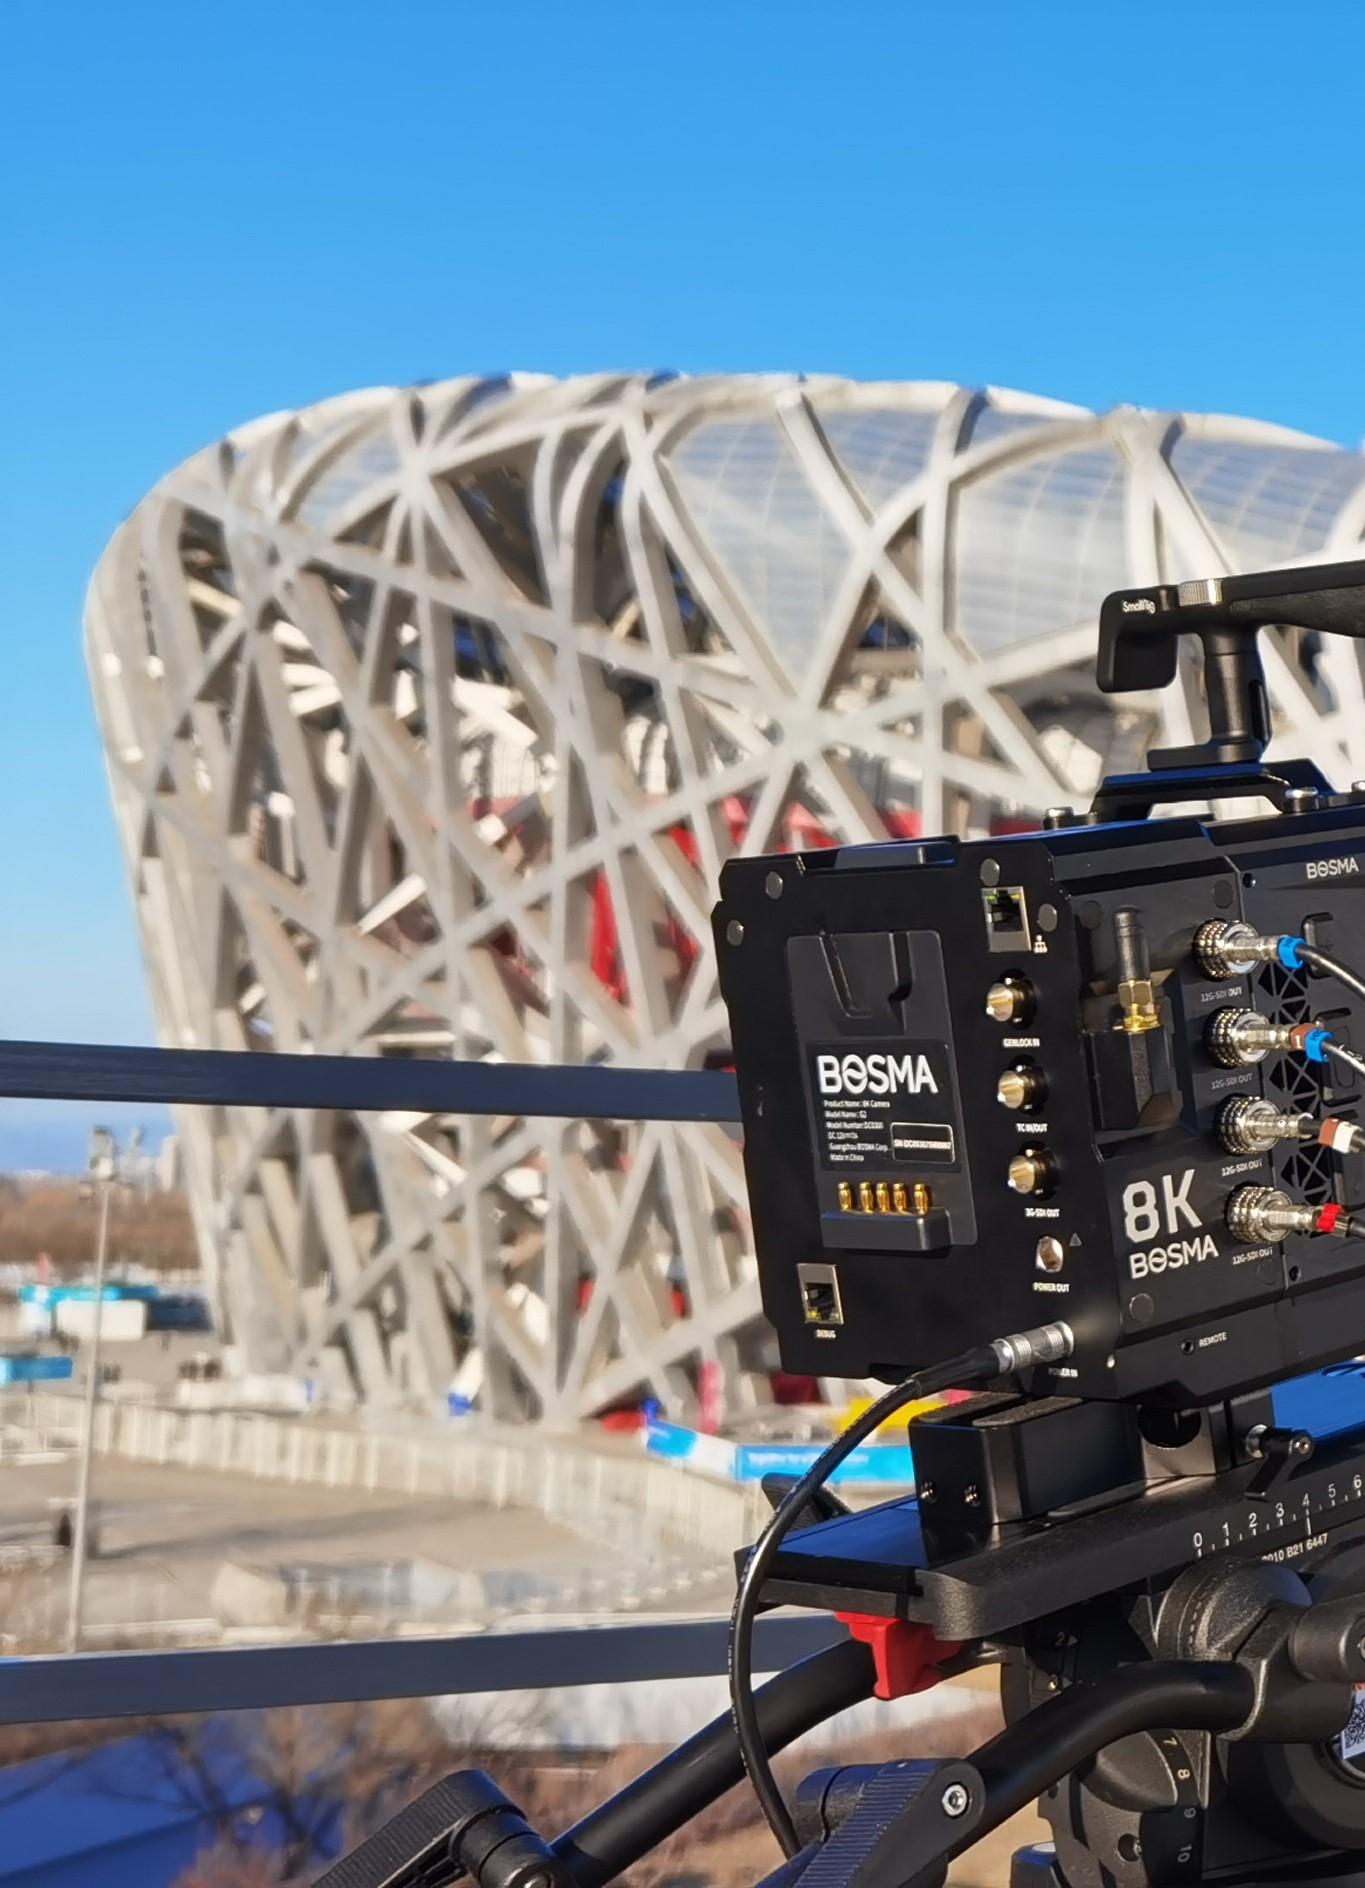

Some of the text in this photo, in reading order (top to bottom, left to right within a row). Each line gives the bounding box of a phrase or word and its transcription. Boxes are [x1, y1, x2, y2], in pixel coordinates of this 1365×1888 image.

[1306, 857, 1359, 879] BOSMA
[1228, 986, 1242, 997] OUT
[817, 1054, 939, 1093] BOSMA
[1238, 1072, 1253, 1084] OUT
[1015, 1122, 1025, 1133] TC
[1248, 1158, 1263, 1170] OUT
[1122, 1169, 1203, 1243] 8K
[1046, 1208, 1060, 1218] OUT
[1129, 1235, 1219, 1279] BOSMA
[1259, 1246, 1273, 1258] OUT
[1056, 1283, 1070, 1293] OUT
[1198, 1331, 1227, 1347] REMOTE
[1193, 1532, 1203, 1547] 0
[1222, 1522, 1230, 1537] 1
[1248, 1512, 1258, 1528] 2
[1275, 1502, 1285, 1518] 3
[1302, 1493, 1310, 1507] 4
[1328, 1483, 1336, 1498] 5
[1353, 1474, 1362, 1489] 6
[1286, 1541, 1304, 1559] B21
[1305, 1532, 1328, 1550] 6447
[1163, 1737, 1178, 1747] 7
[1177, 1768, 1190, 1780] 8
[1184, 1807, 1196, 1819] 9
[1177, 1845, 1192, 1863] 10
